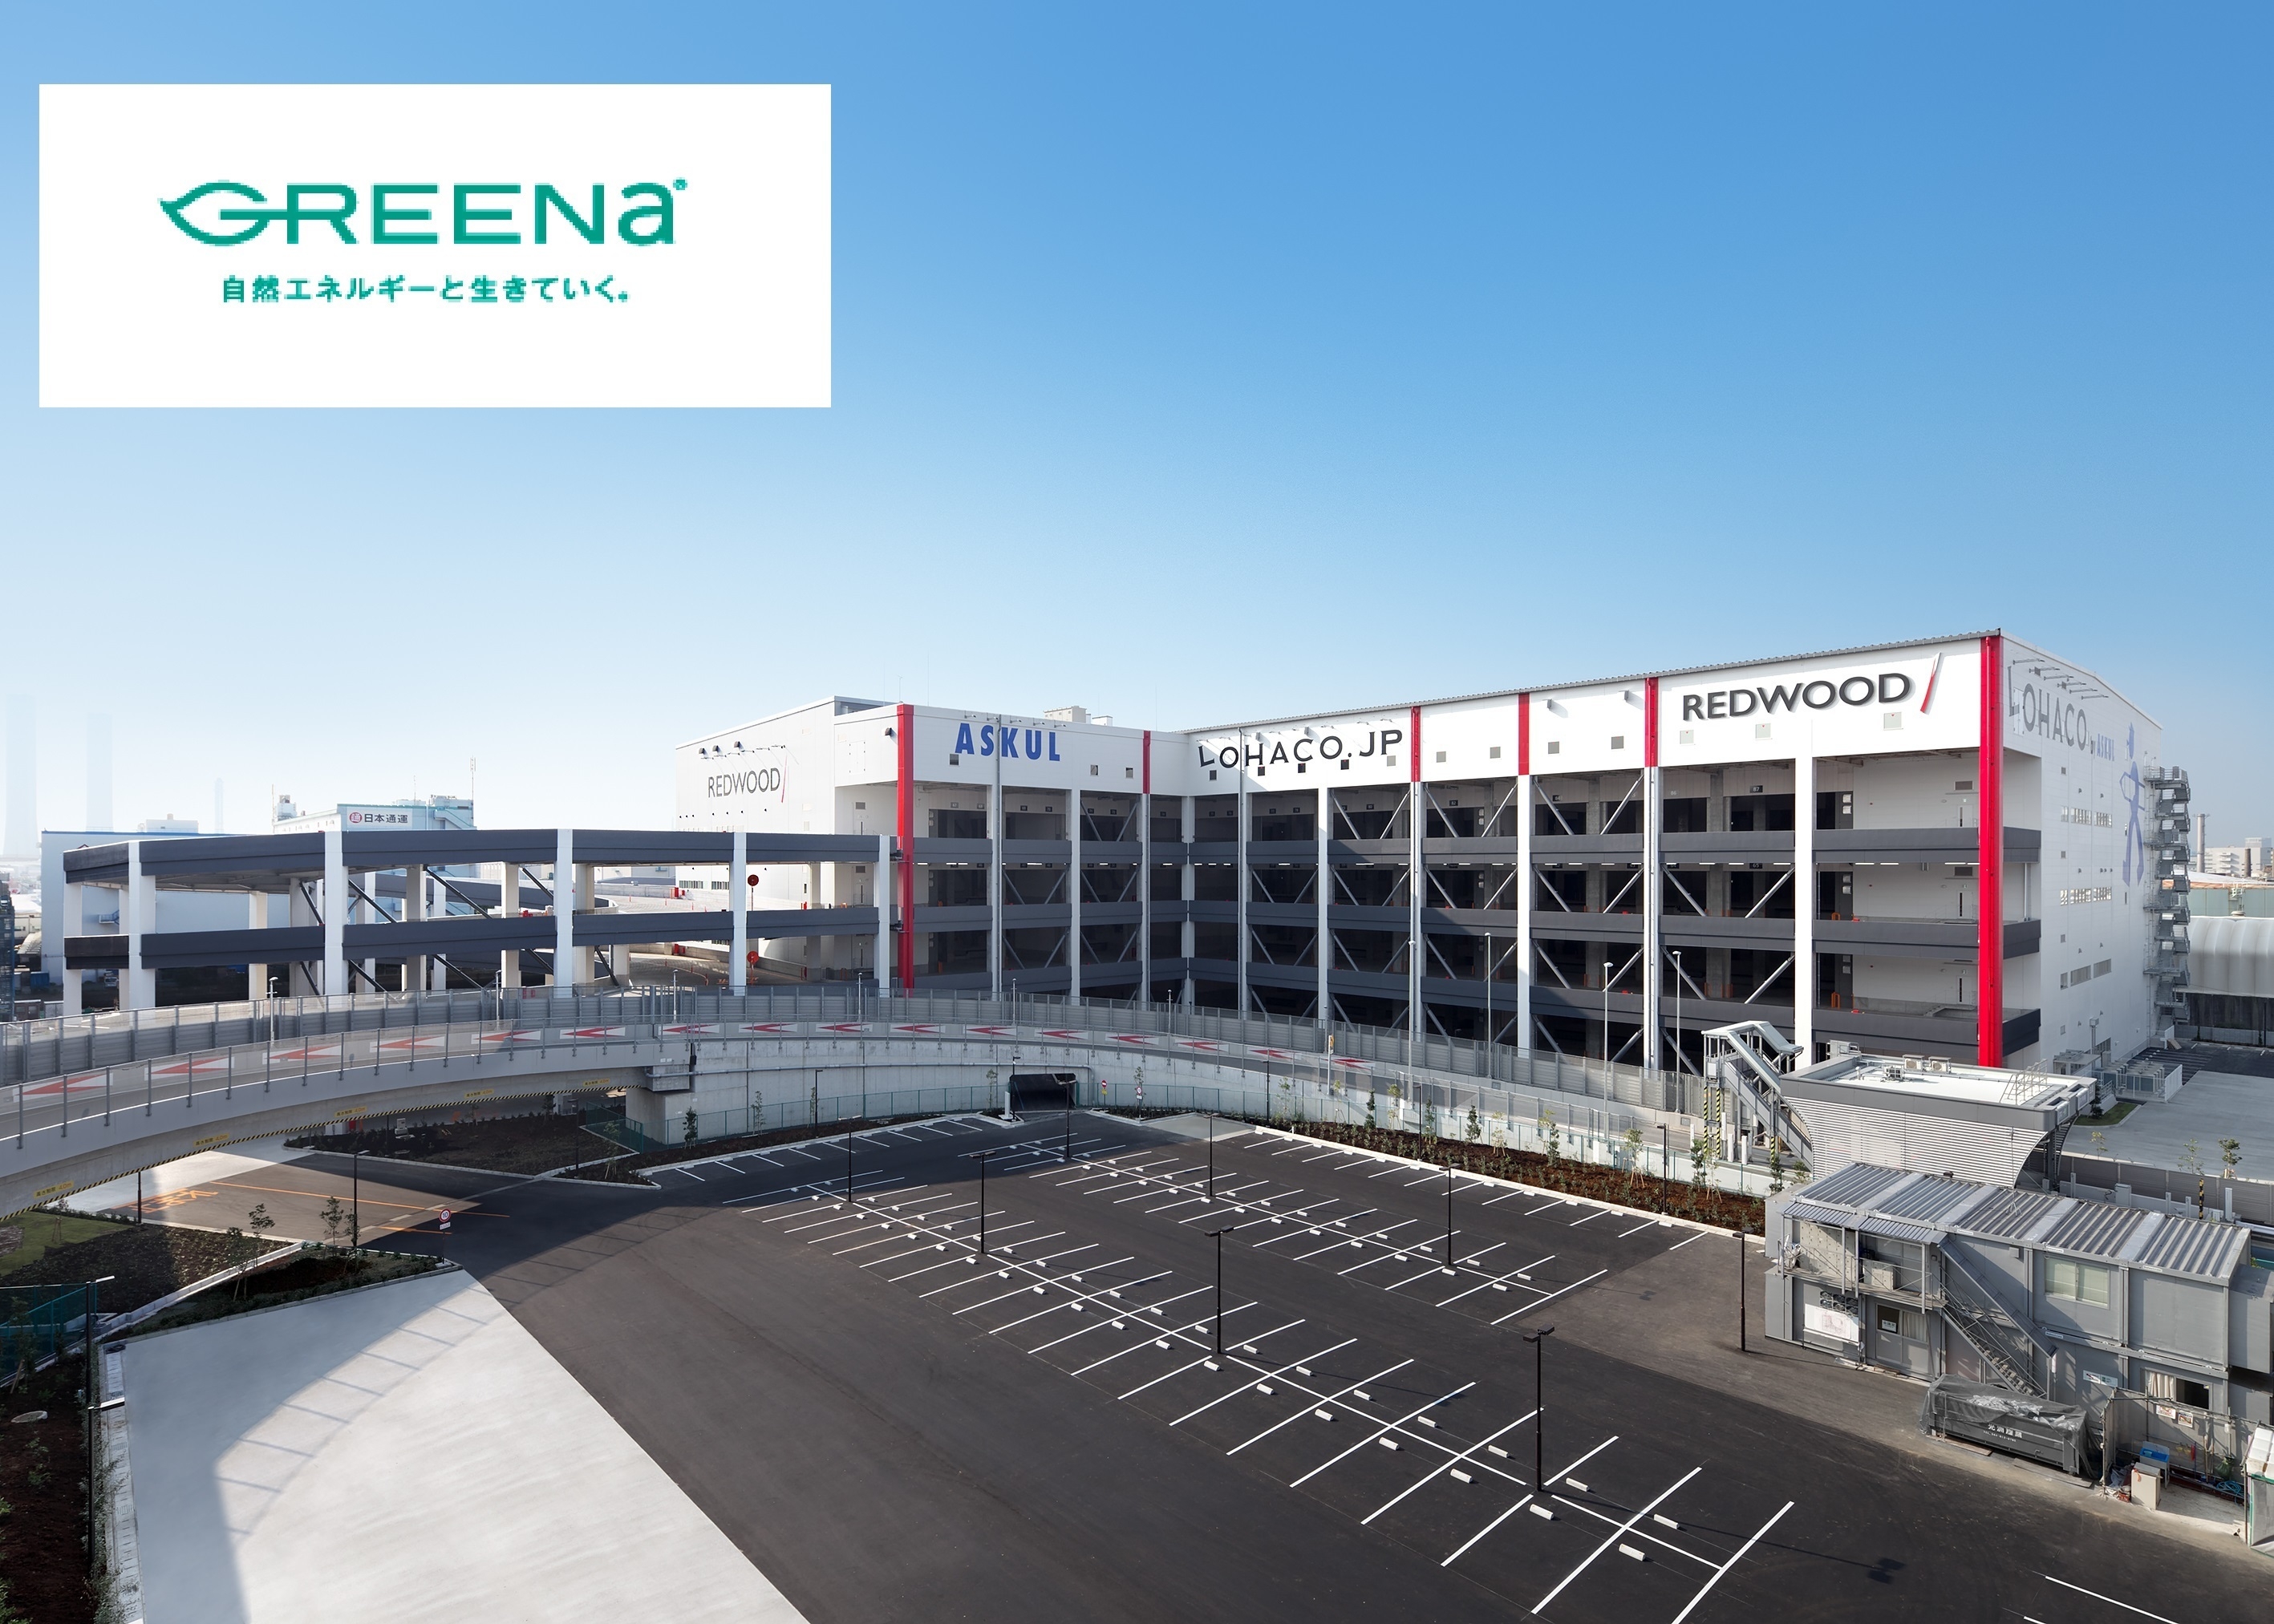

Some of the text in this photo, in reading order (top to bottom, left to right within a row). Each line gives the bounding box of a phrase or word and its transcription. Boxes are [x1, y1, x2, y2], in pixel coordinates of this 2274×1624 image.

[1683, 673, 1911, 722] REDWOOD
[2008, 666, 2087, 751] LOHACO
[955, 723, 1060, 762] ASKUL
[1198, 729, 1403, 768] LOHACO.JP
[708, 767, 780, 798] REDWOOD
[364, 814, 408, 823] 日本通運
